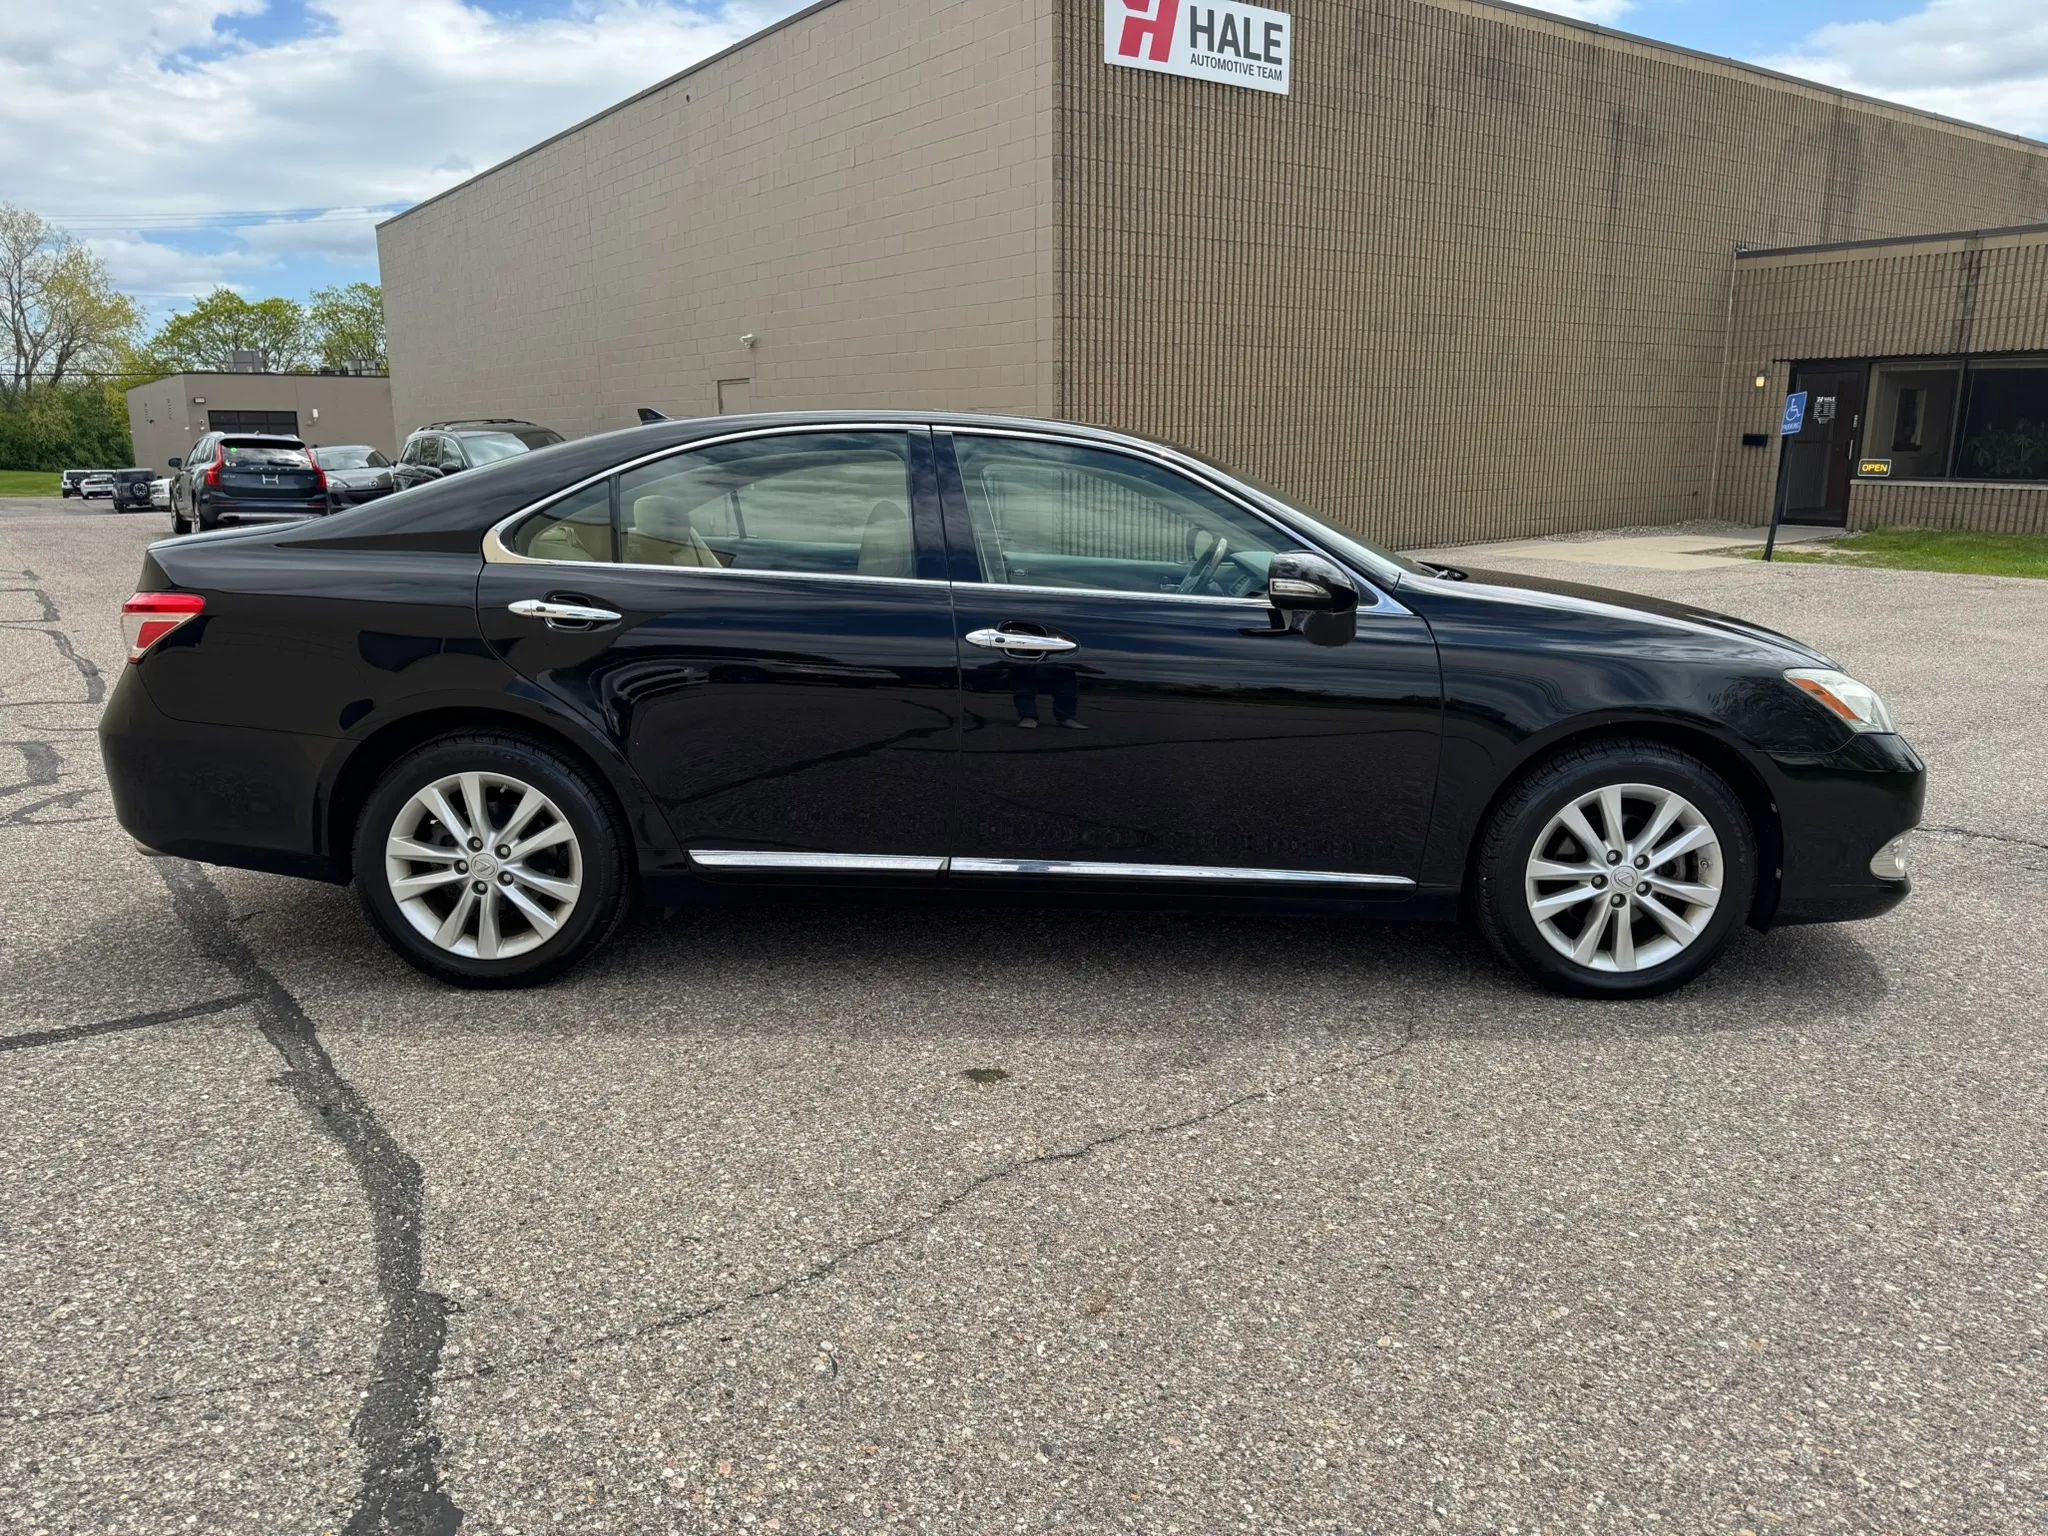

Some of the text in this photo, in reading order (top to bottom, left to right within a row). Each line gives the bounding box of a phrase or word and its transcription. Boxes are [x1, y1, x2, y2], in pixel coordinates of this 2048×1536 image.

[1190, 5, 1283, 66] HALE
[1190, 53, 1283, 81] AUTOMOTIVE TEAM
[1862, 463, 1888, 472] OPEN
